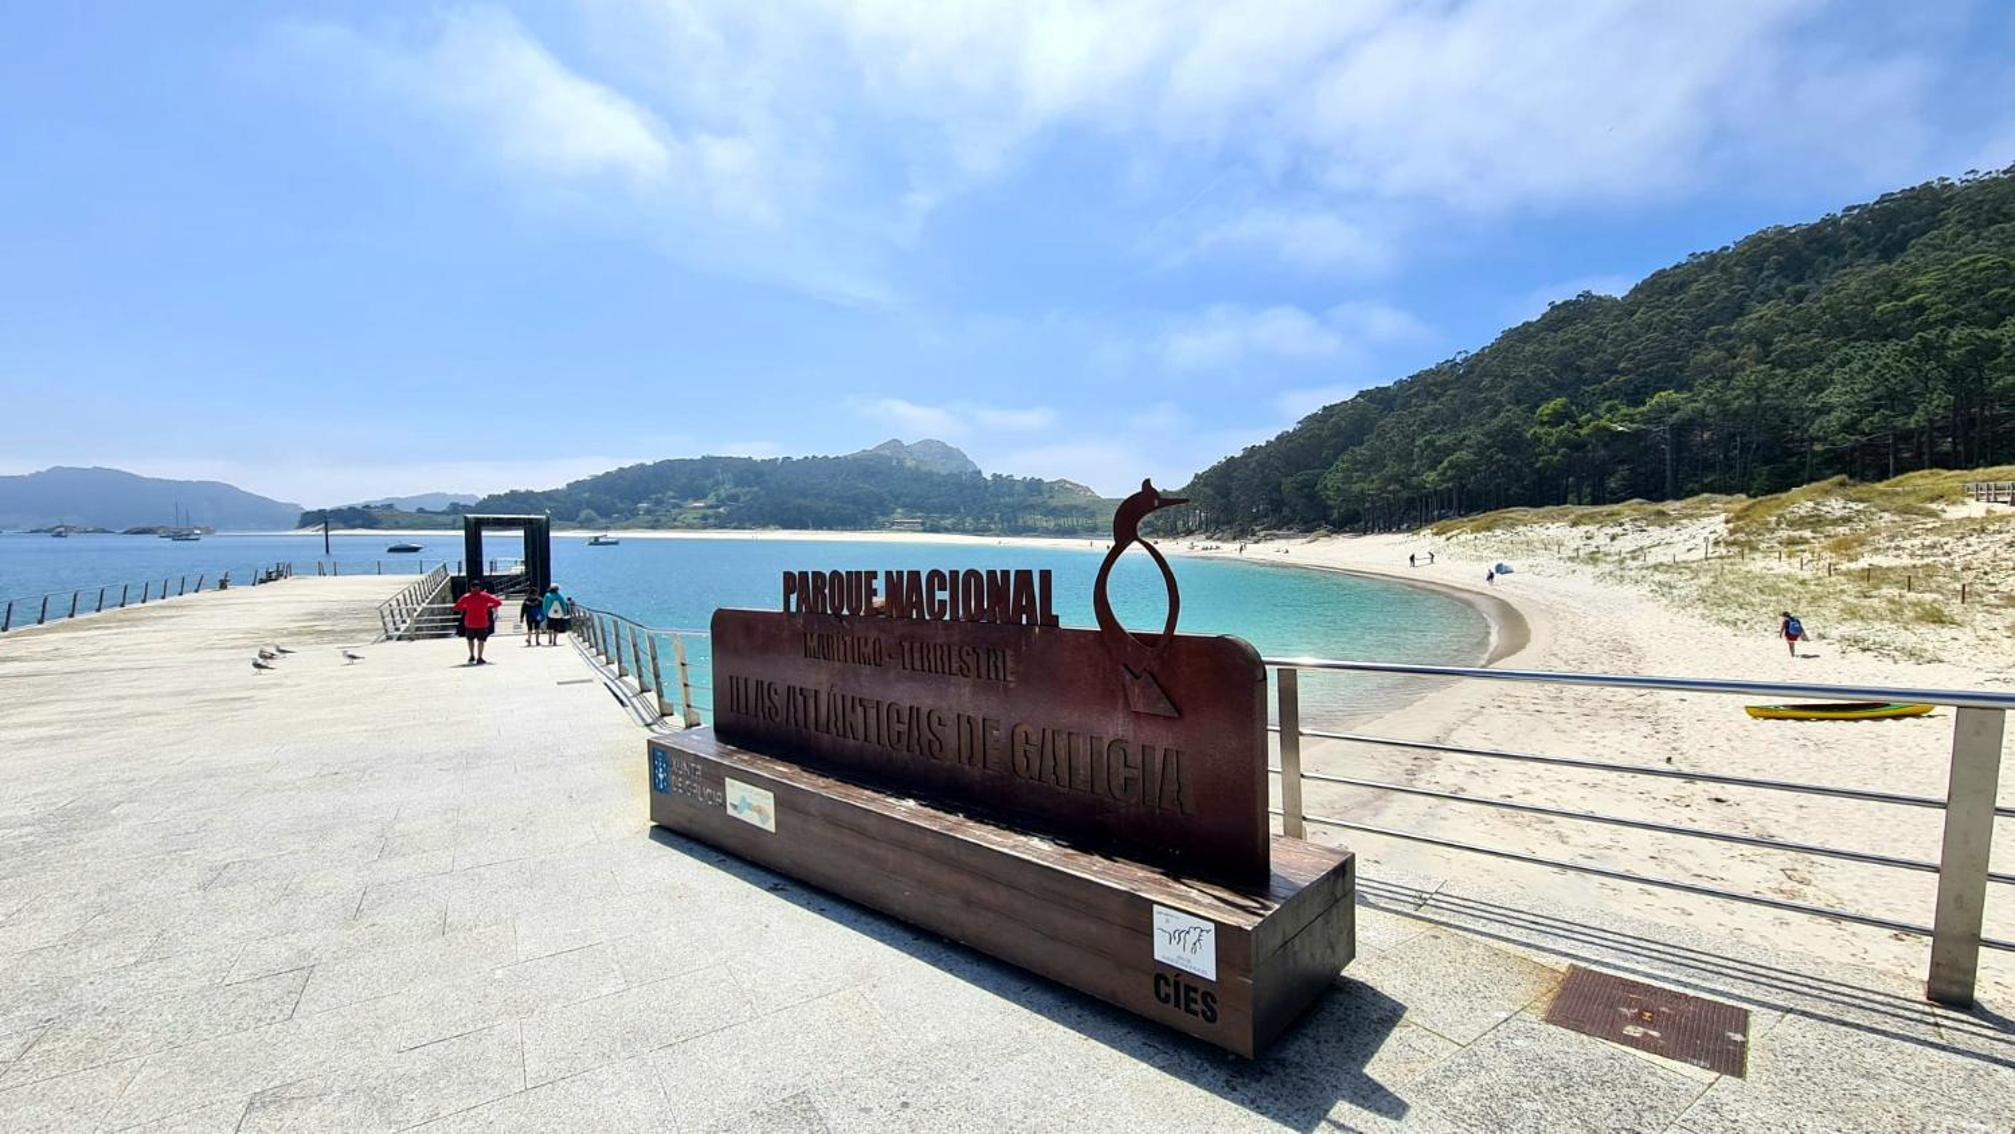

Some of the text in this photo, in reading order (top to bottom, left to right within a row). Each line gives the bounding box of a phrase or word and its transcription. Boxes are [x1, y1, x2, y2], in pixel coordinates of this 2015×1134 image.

[783, 569, 1059, 627] PARQUE NACIONAL
[803, 631, 883, 667] MARÍTIMO
[900, 641, 1016, 683] TERRESTRE
[729, 675, 1194, 816] ILLAS ATLÁNTICAS DE GALICIA
[1154, 972, 1218, 1024] CÍES
